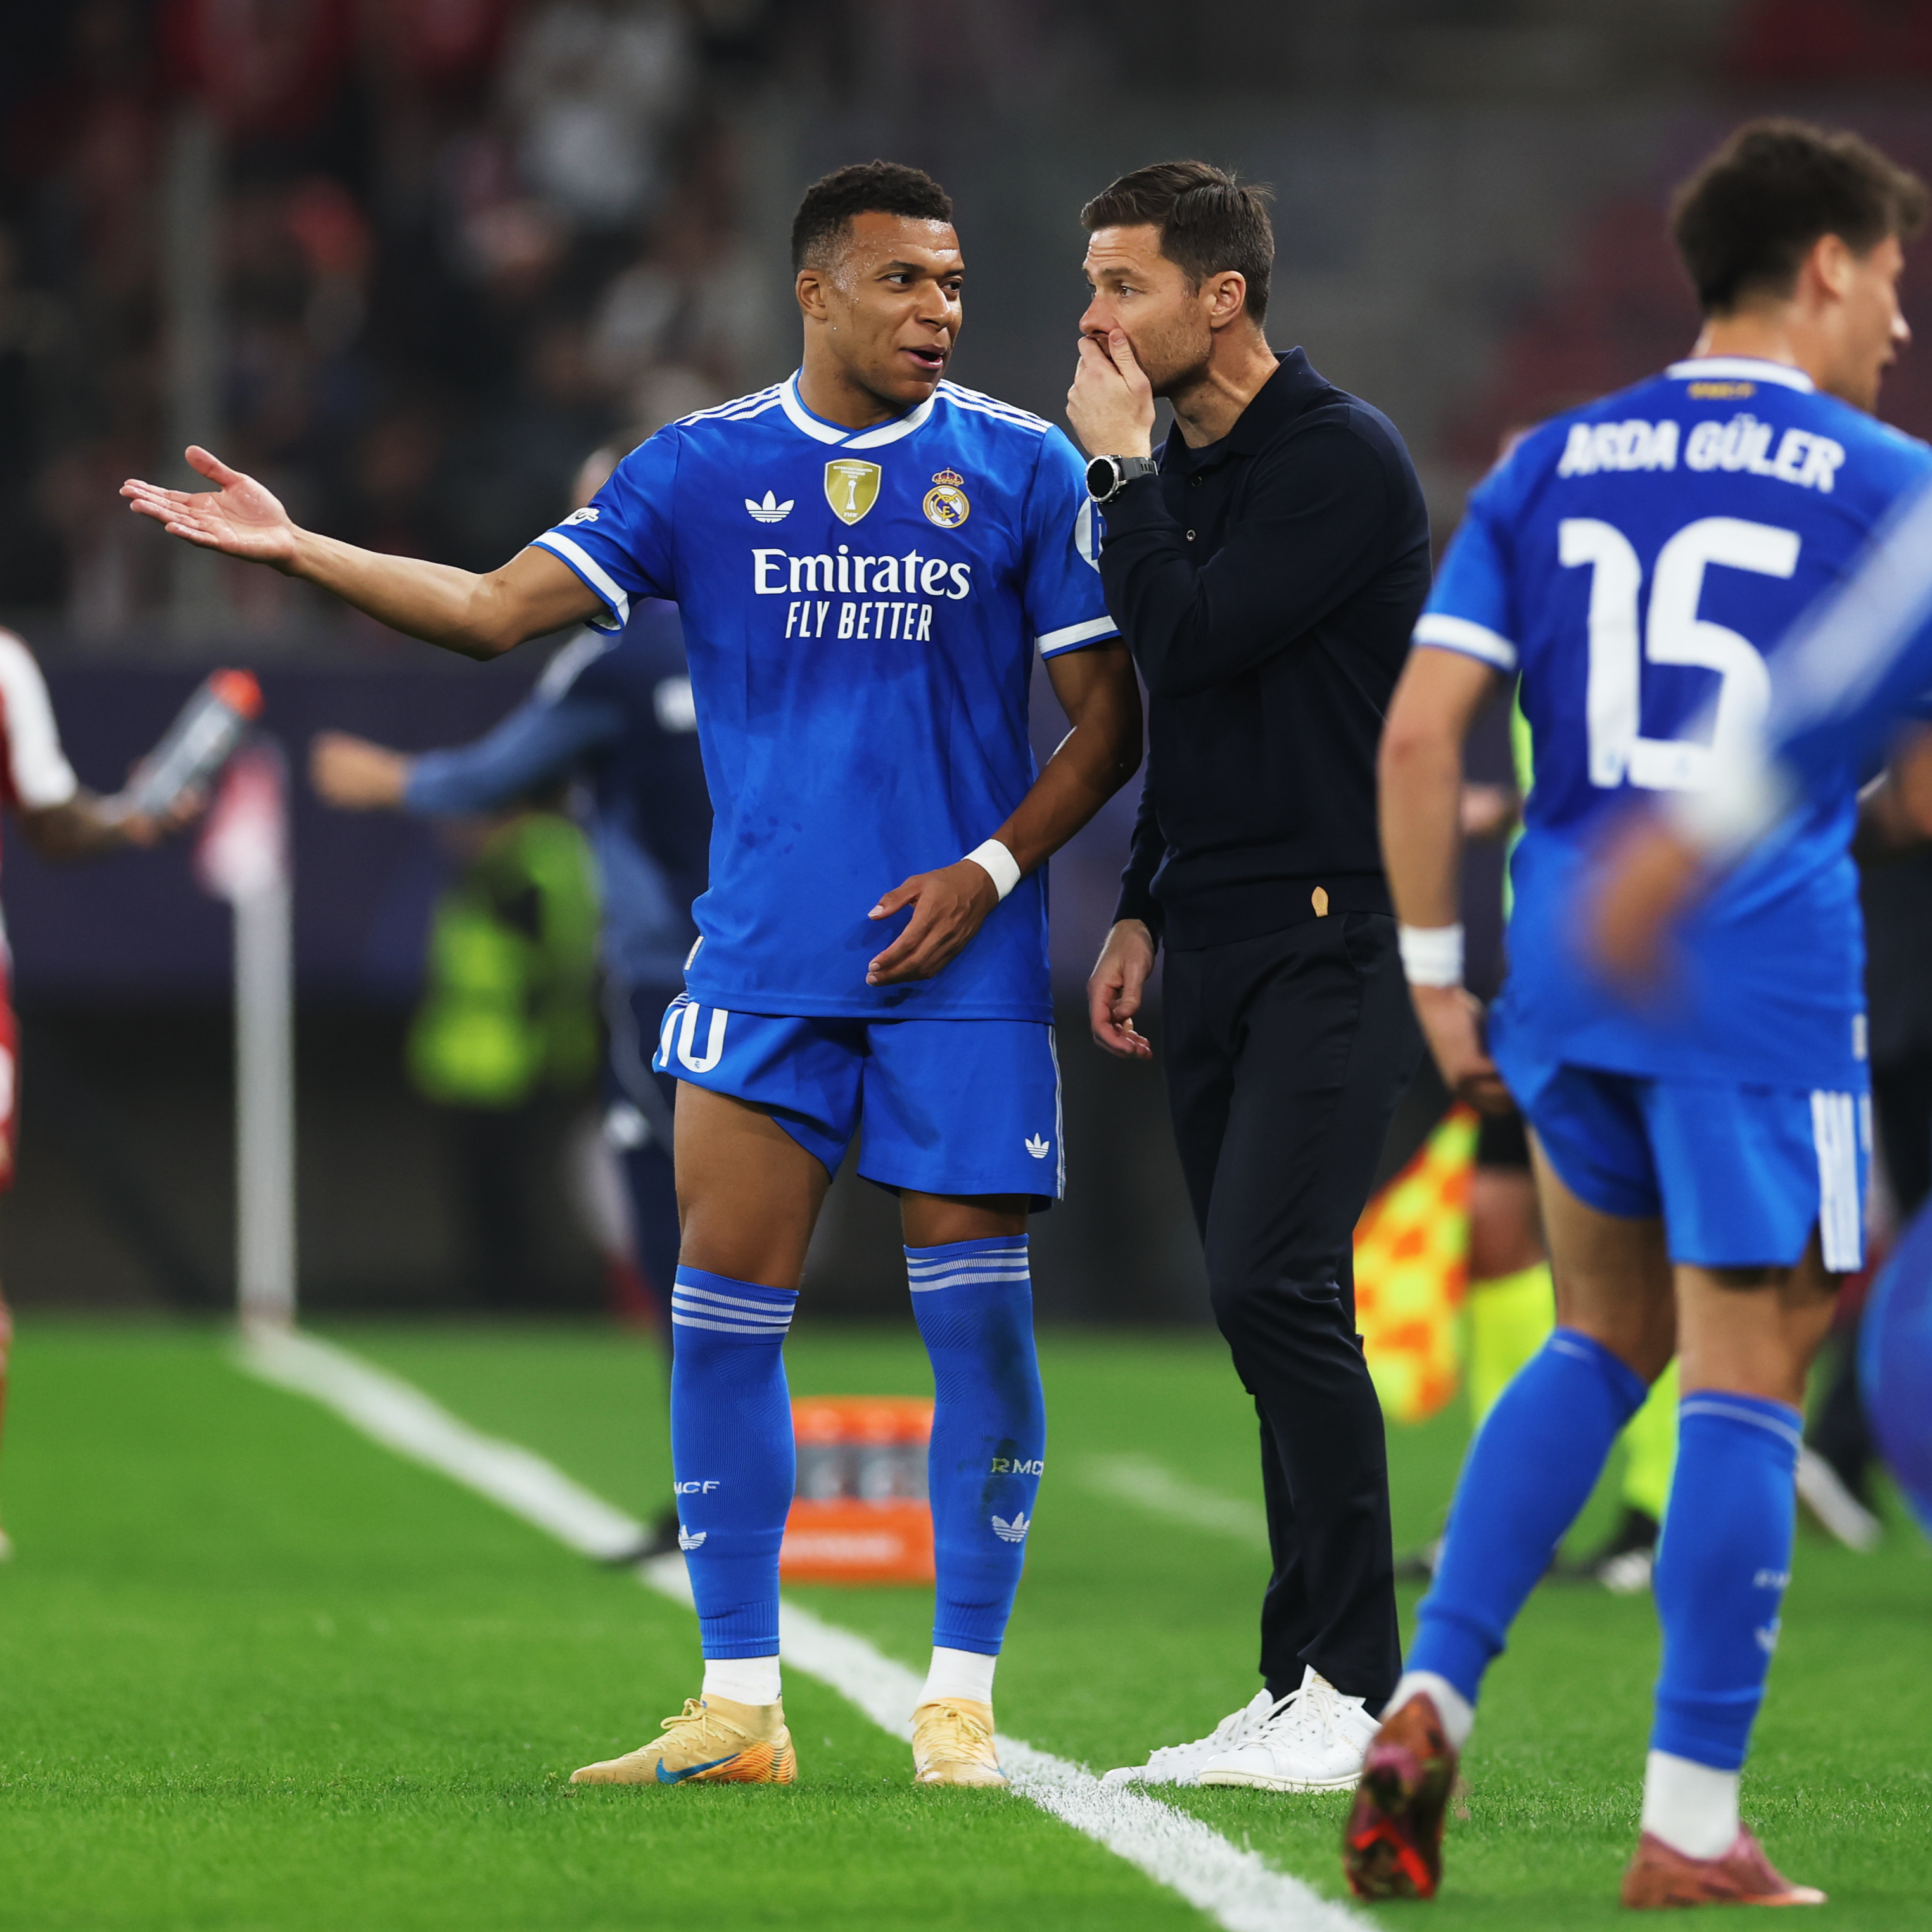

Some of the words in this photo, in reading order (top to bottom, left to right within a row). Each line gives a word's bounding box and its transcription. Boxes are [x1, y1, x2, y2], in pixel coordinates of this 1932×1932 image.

[1557, 419, 1681, 479] ARDA
[1684, 413, 1846, 494] GÜLER
[751, 544, 970, 600] Emirates
[785, 601, 830, 639] FLY
[837, 602, 932, 642] BETTER
[1558, 516, 1802, 791] 15
[991, 1458, 1045, 1477] RMC
